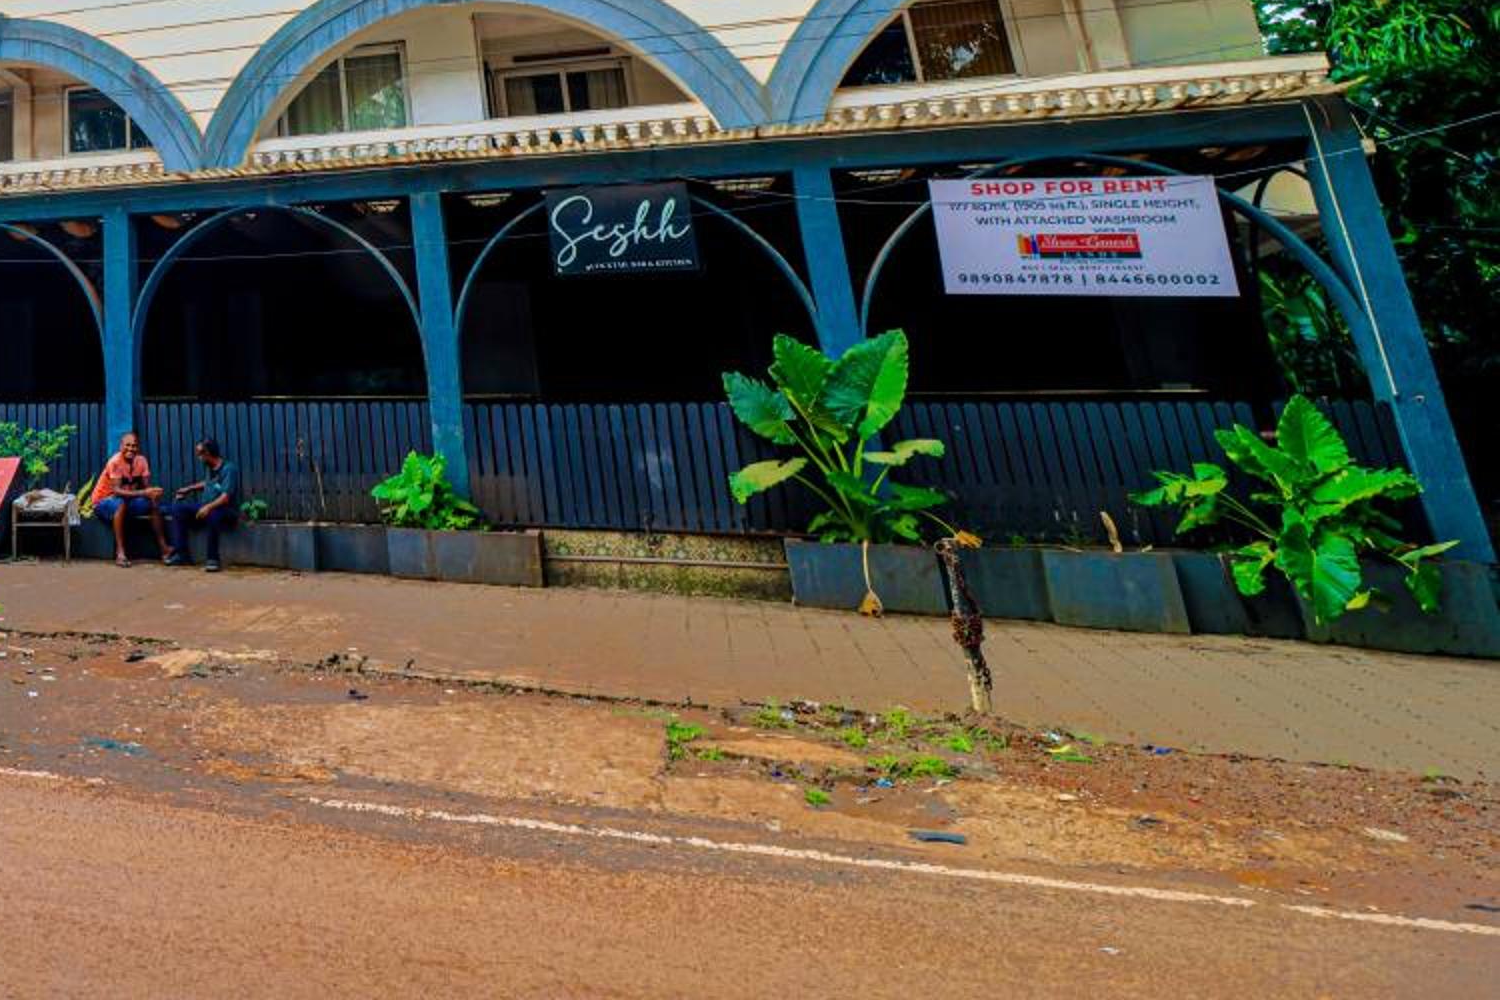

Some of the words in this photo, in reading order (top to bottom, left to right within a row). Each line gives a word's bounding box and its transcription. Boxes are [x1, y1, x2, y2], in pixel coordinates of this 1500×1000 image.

[971, 182, 1035, 196] SHOP
[1044, 180, 1093, 194] FOR
[1103, 179, 1167, 194] RENT
[1092, 199, 1140, 209] SINGLE
[975, 215, 1011, 225] WITH
[1014, 215, 1086, 225] ATTACHED
[1090, 214, 1177, 225] WASHROOM
